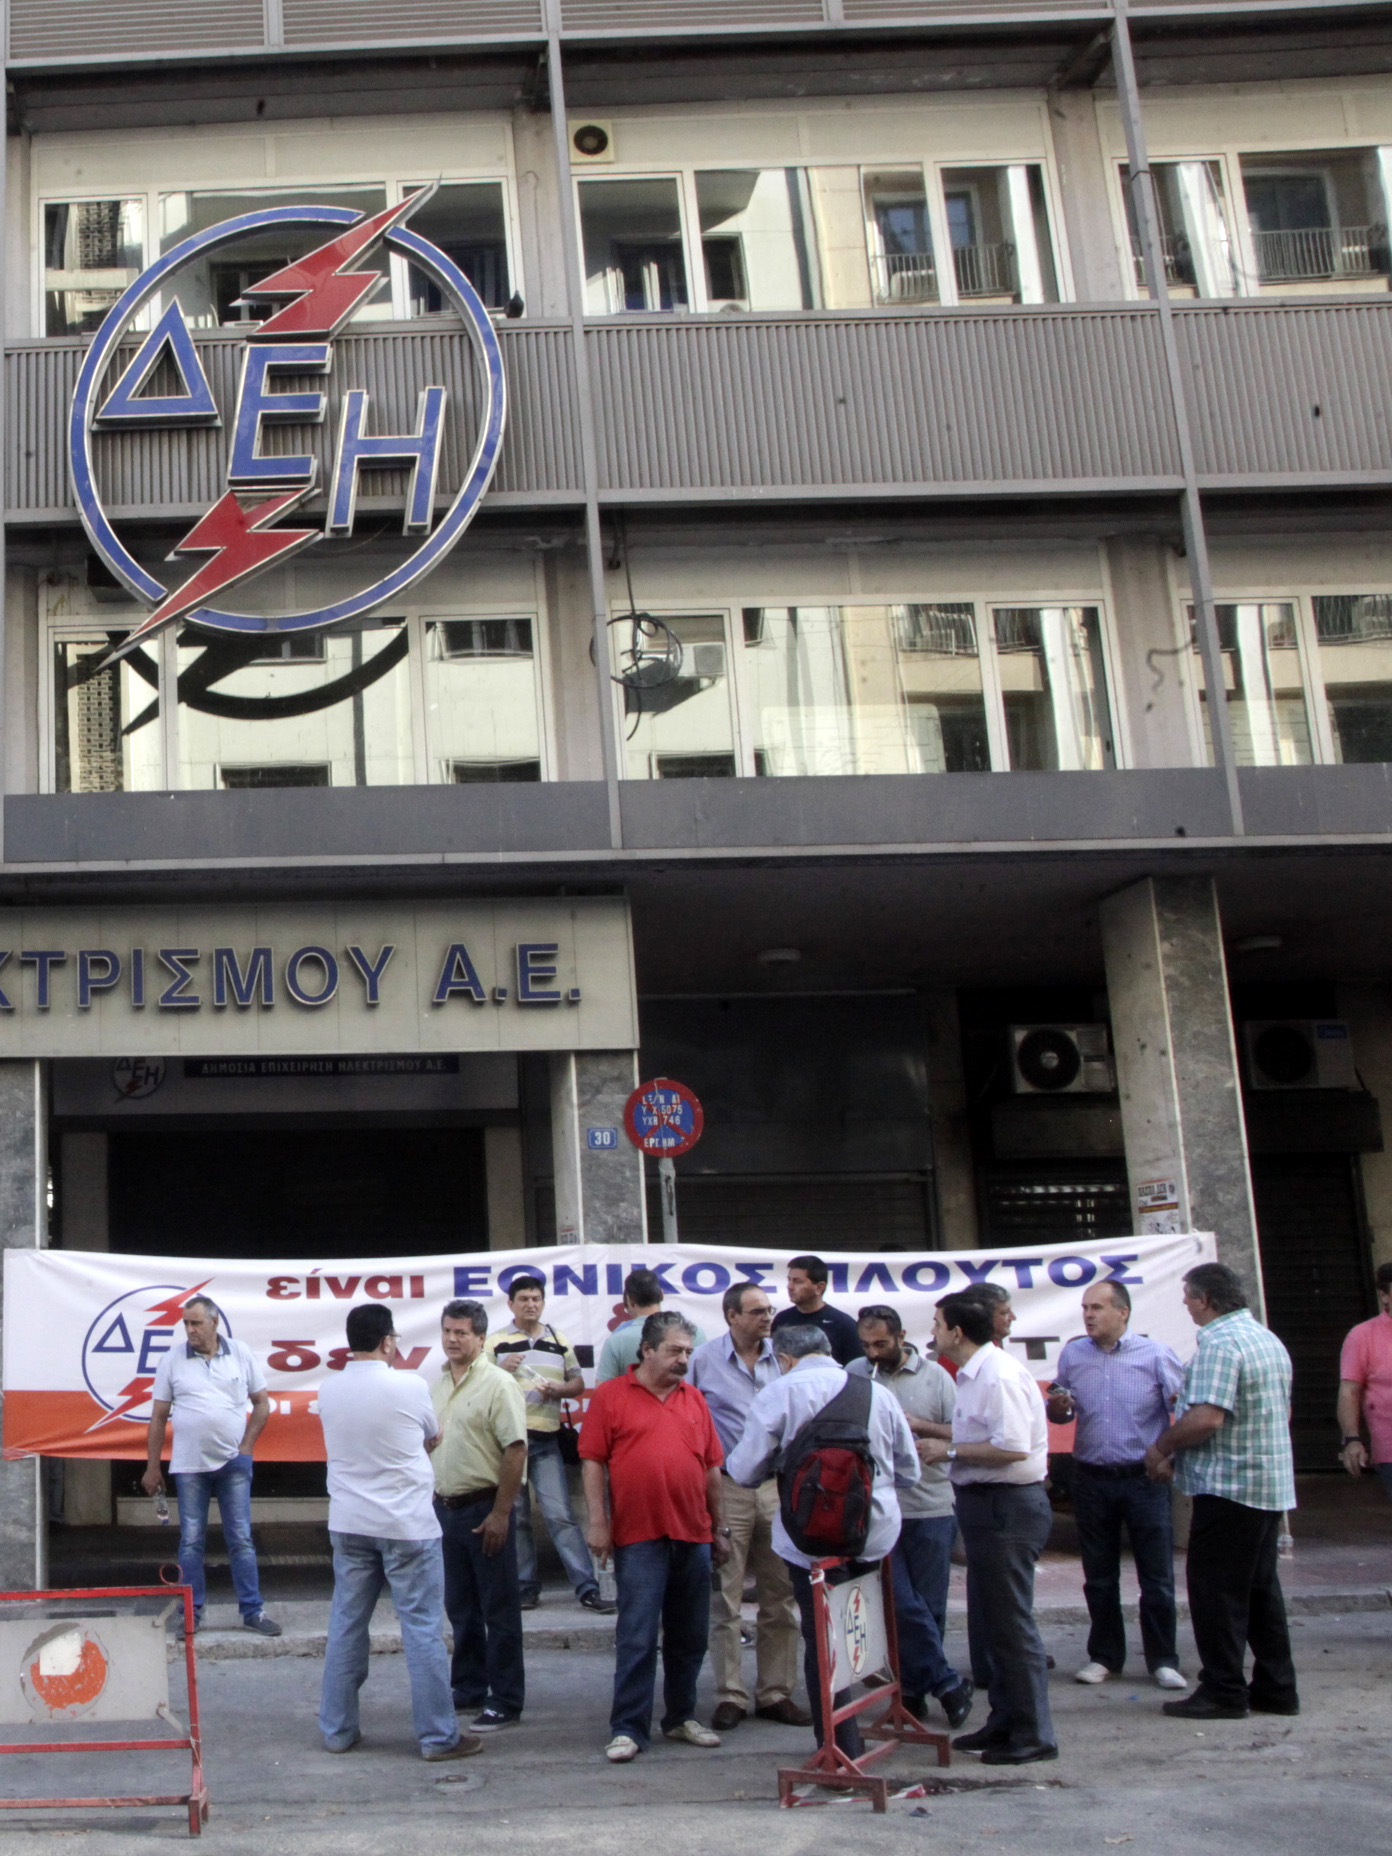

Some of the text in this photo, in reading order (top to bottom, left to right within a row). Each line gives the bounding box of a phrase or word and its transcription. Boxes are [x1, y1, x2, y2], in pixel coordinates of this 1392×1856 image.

[92, 296, 446, 537] ΔΕΗ
[432, 941, 582, 1004] Α.Ε.
[115, 1056, 160, 1086] ΔΕΗ
[202, 1062, 256, 1074] ΔΗΜΟΣΙΑ
[261, 1060, 333, 1073] ΕΠΙΧΕΙΡΗΣΗ
[338, 1059, 421, 1072] ΗΛΕΚΤΡΙΣΜΟΥ
[663, 1115, 681, 1126] 746
[594, 1132, 611, 1146] 30
[265, 1268, 425, 1300] είναι
[91, 1312, 174, 1374] ΔΕ
[847, 1607, 866, 1655] ΔΕΗ
